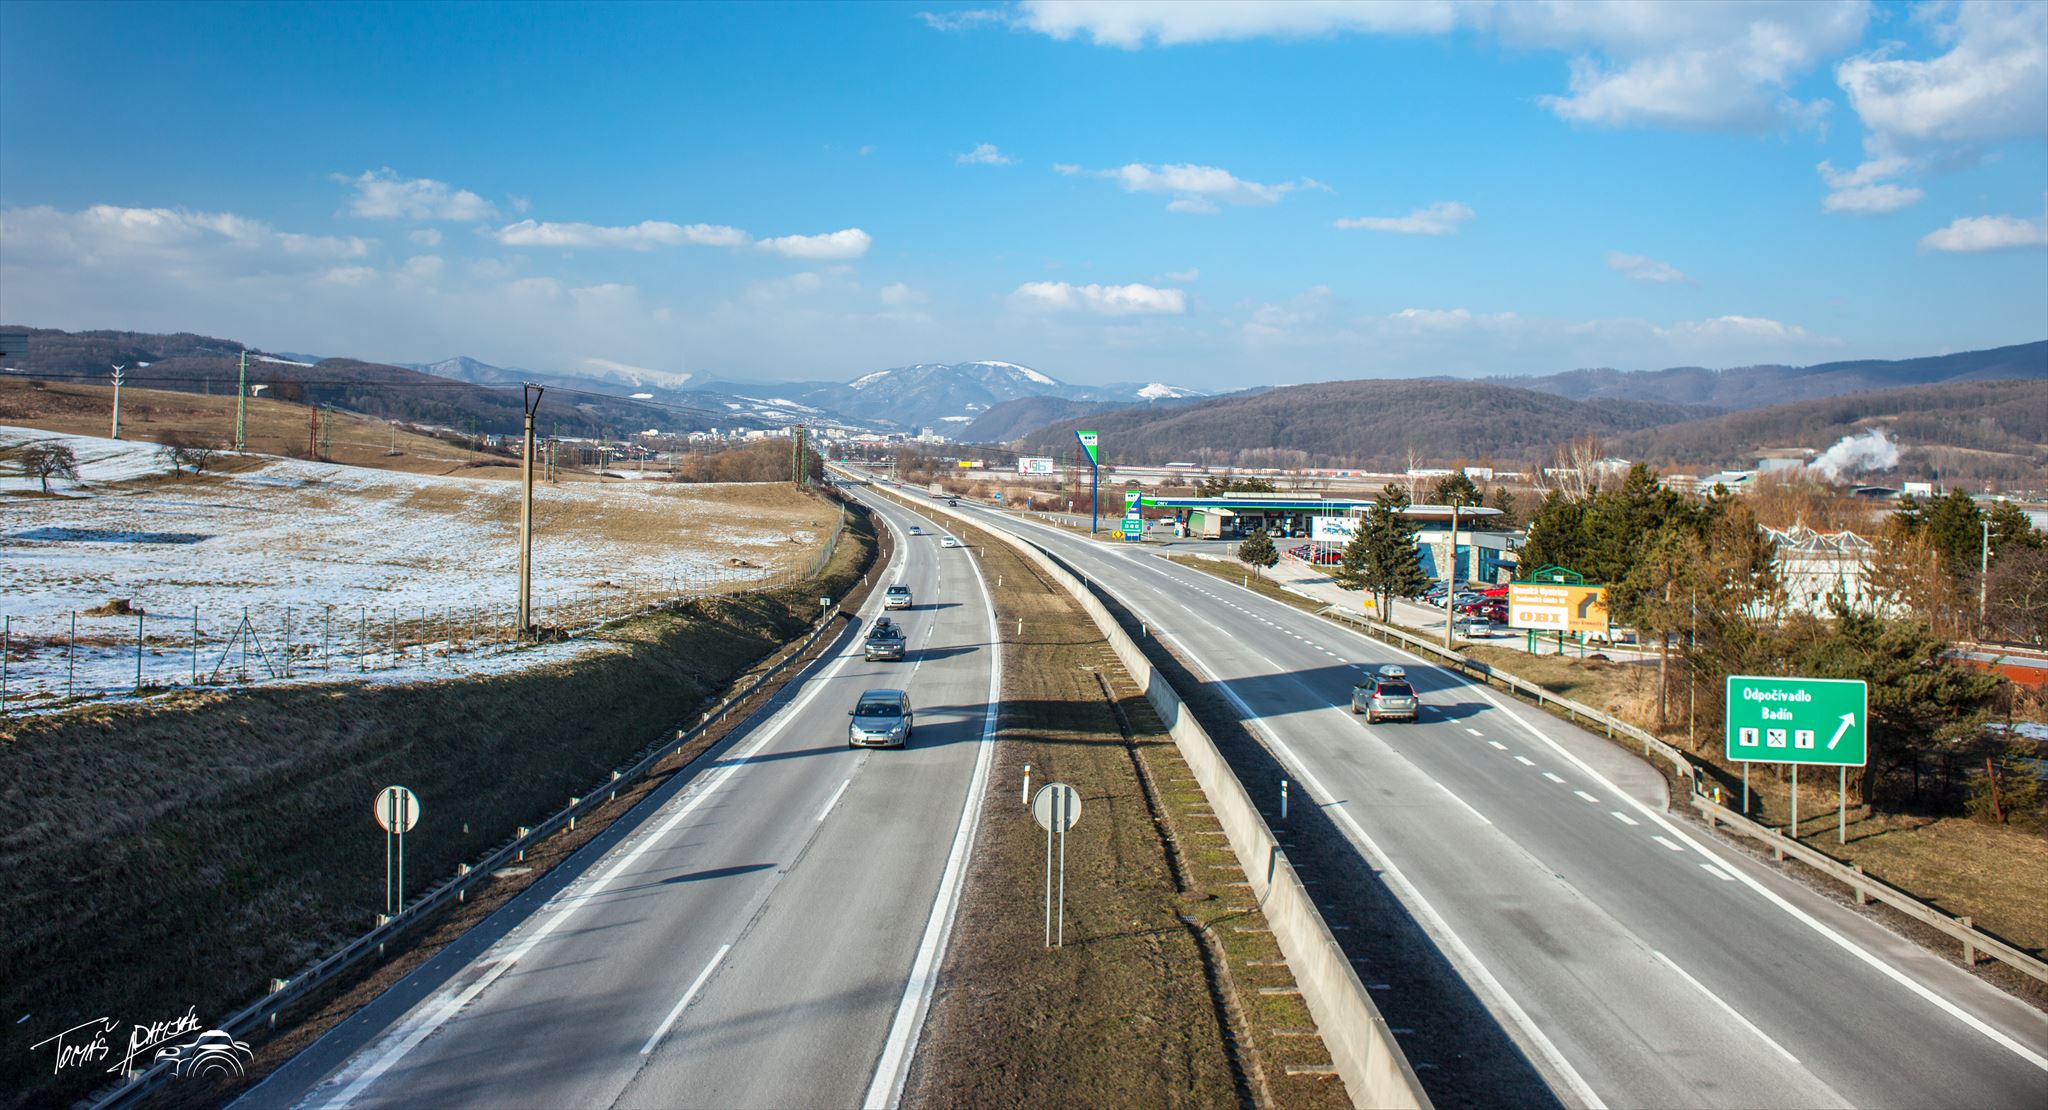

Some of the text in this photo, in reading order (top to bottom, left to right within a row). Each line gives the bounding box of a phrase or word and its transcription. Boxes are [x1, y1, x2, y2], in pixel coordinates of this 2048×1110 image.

[1519, 611, 1560, 623] OBI
[1743, 687, 1812, 703] Odpočívadlo
[1761, 706, 1793, 721] Badín
